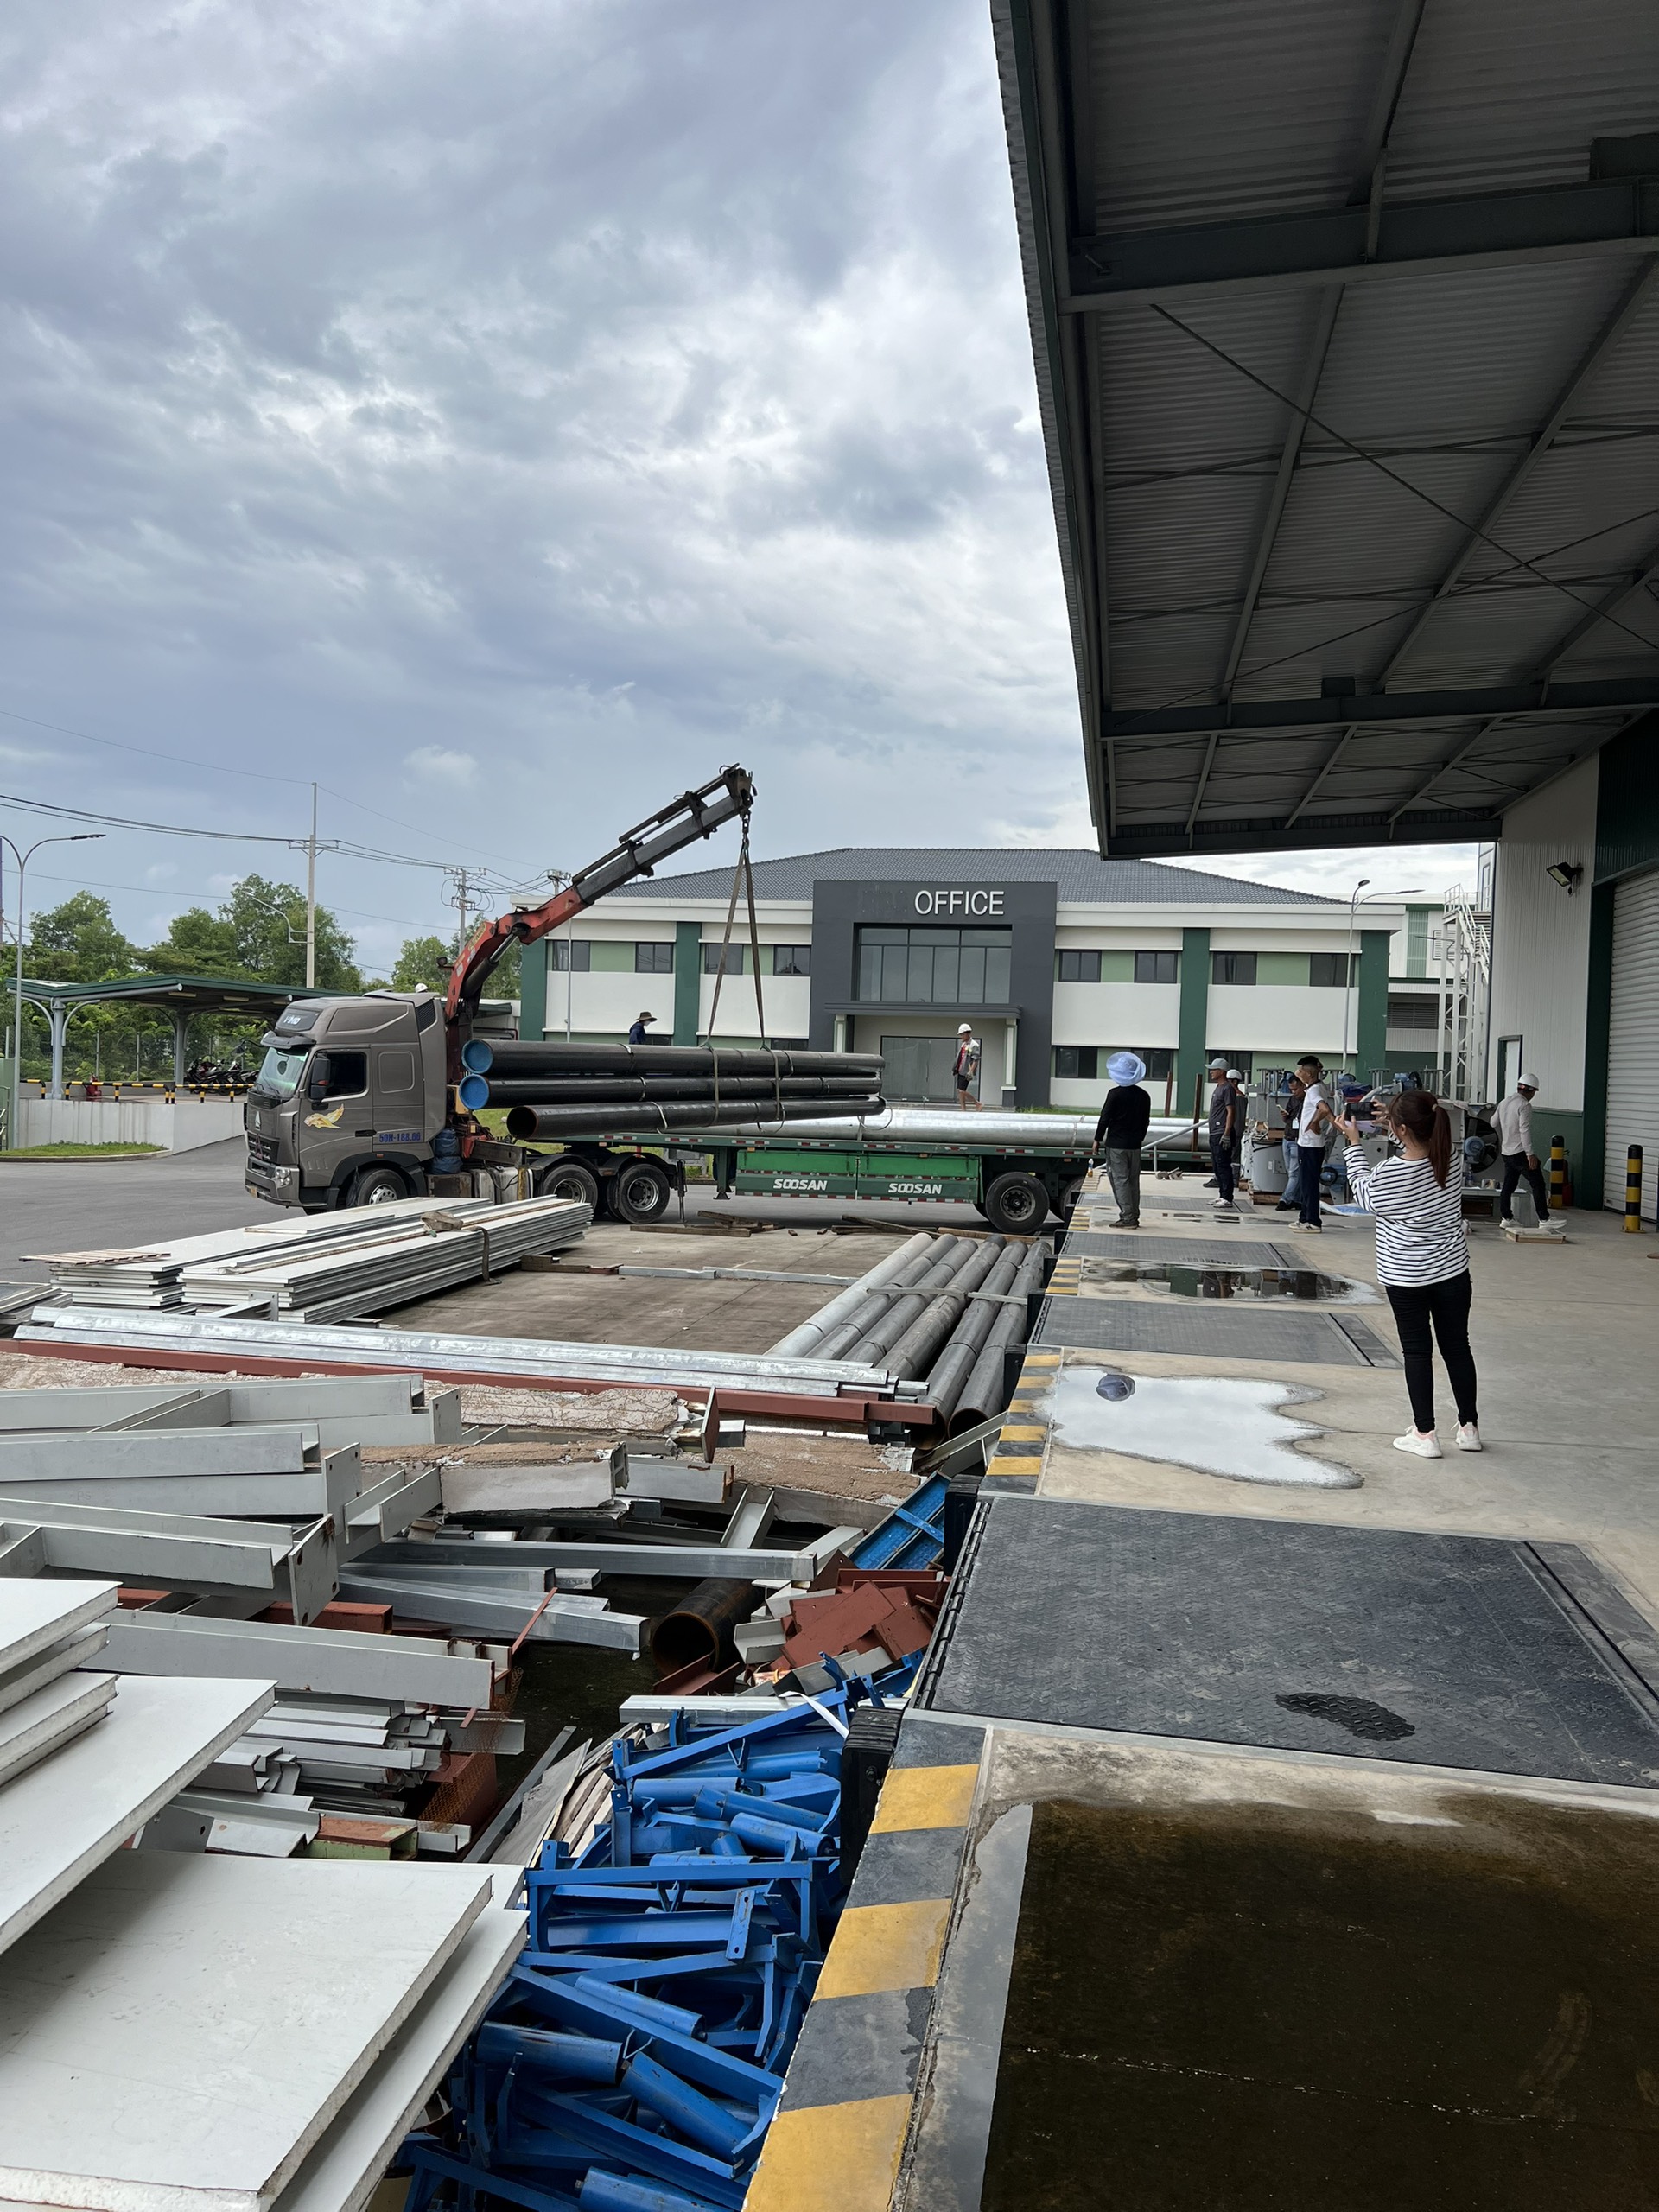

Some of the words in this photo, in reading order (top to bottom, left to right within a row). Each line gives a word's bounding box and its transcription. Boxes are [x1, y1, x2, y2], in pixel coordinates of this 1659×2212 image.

[914, 890, 1004, 915] OFFICE
[773, 1179, 828, 1191] SOOSAN
[888, 1183, 942, 1194] SOOSAN
